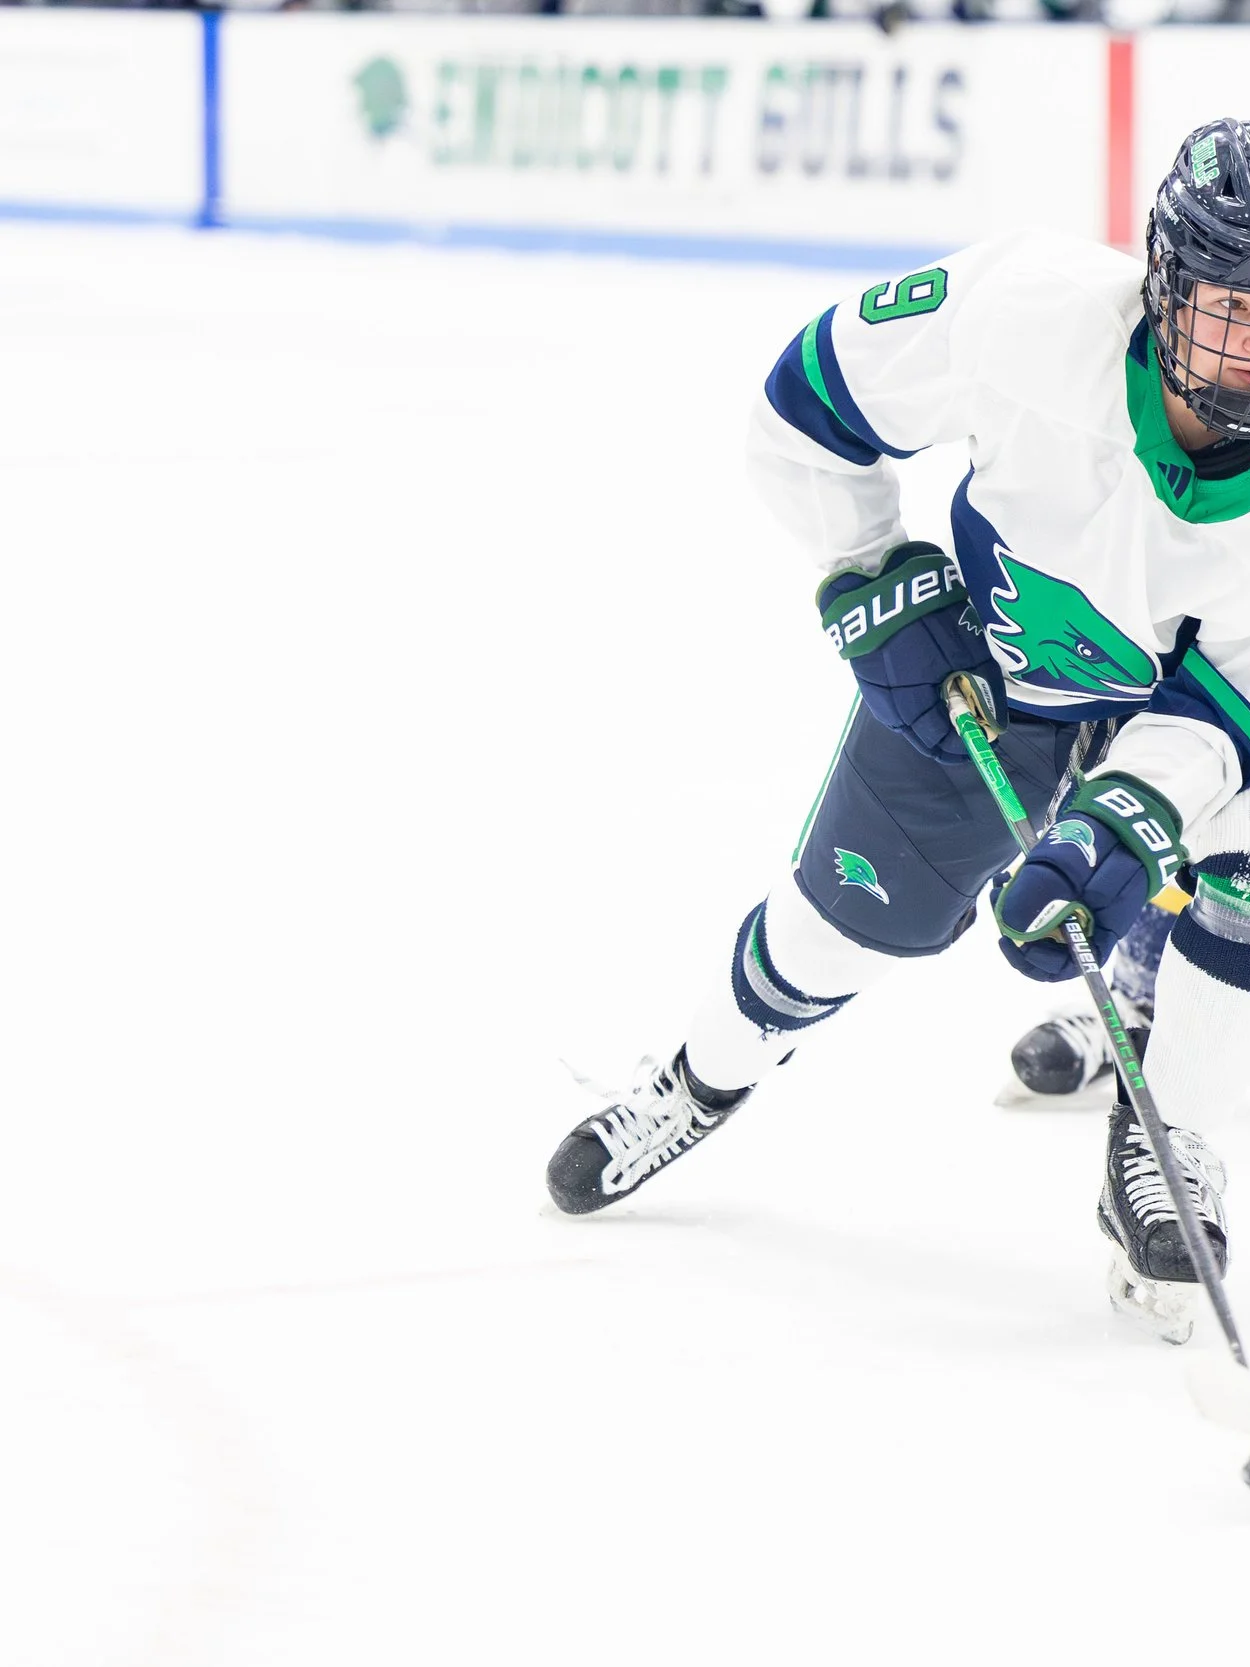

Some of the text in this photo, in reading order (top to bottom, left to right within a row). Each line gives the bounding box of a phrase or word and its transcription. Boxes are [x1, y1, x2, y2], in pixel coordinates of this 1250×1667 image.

[858, 266, 949, 326] 9
[1093, 787, 1179, 885] BAU
[1066, 921, 1100, 973] BAUER
